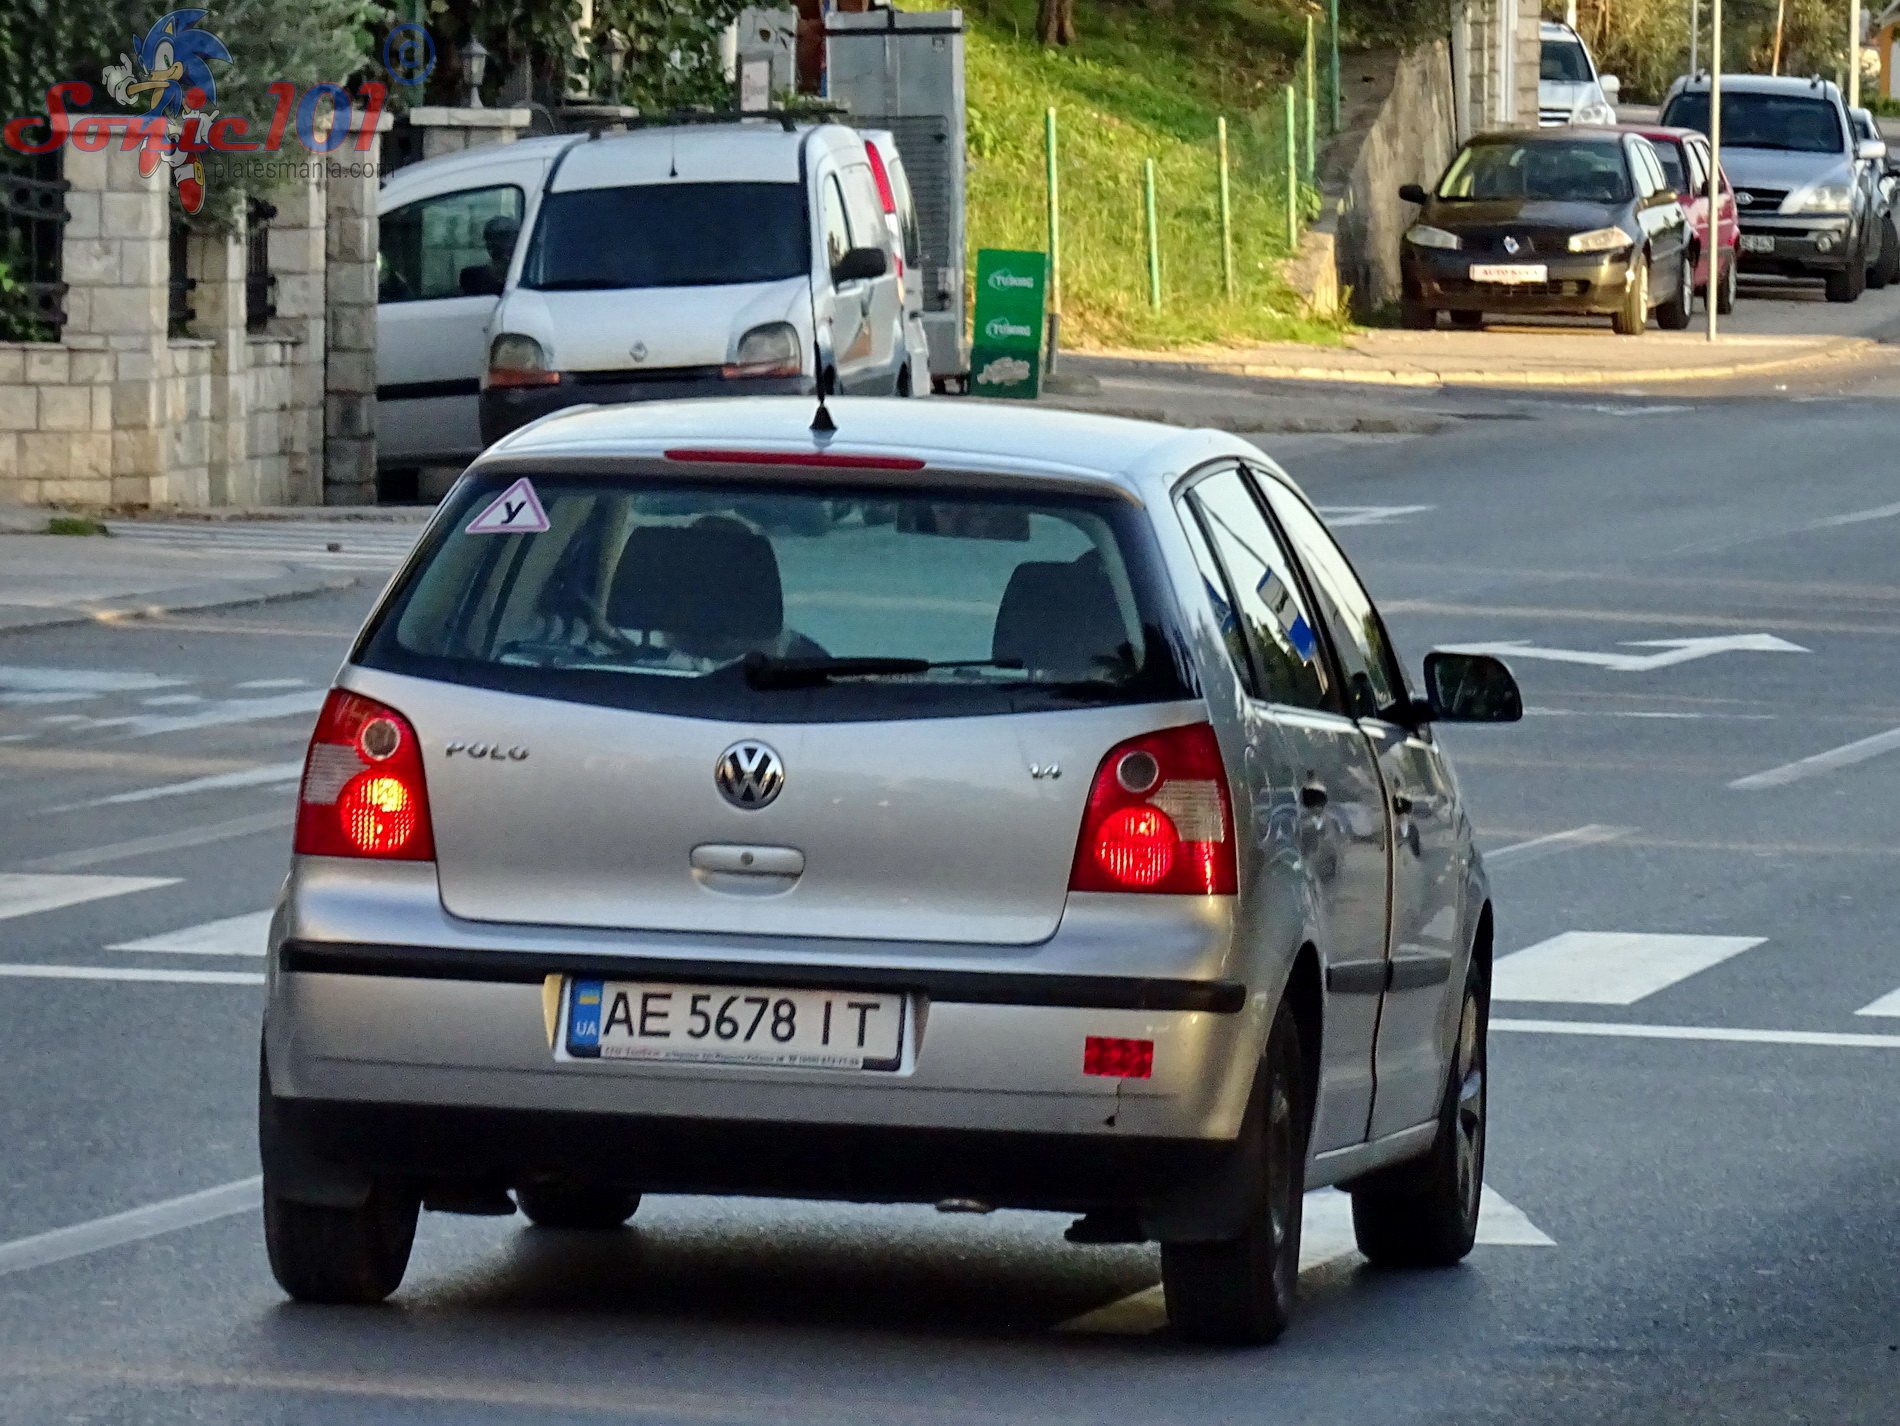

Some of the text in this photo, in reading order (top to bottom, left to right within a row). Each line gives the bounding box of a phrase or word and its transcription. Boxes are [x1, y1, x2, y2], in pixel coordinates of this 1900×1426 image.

[445, 741, 530, 762] POLO
[575, 1020, 597, 1036] UA
[602, 991, 881, 1048] AE 5678 IT
